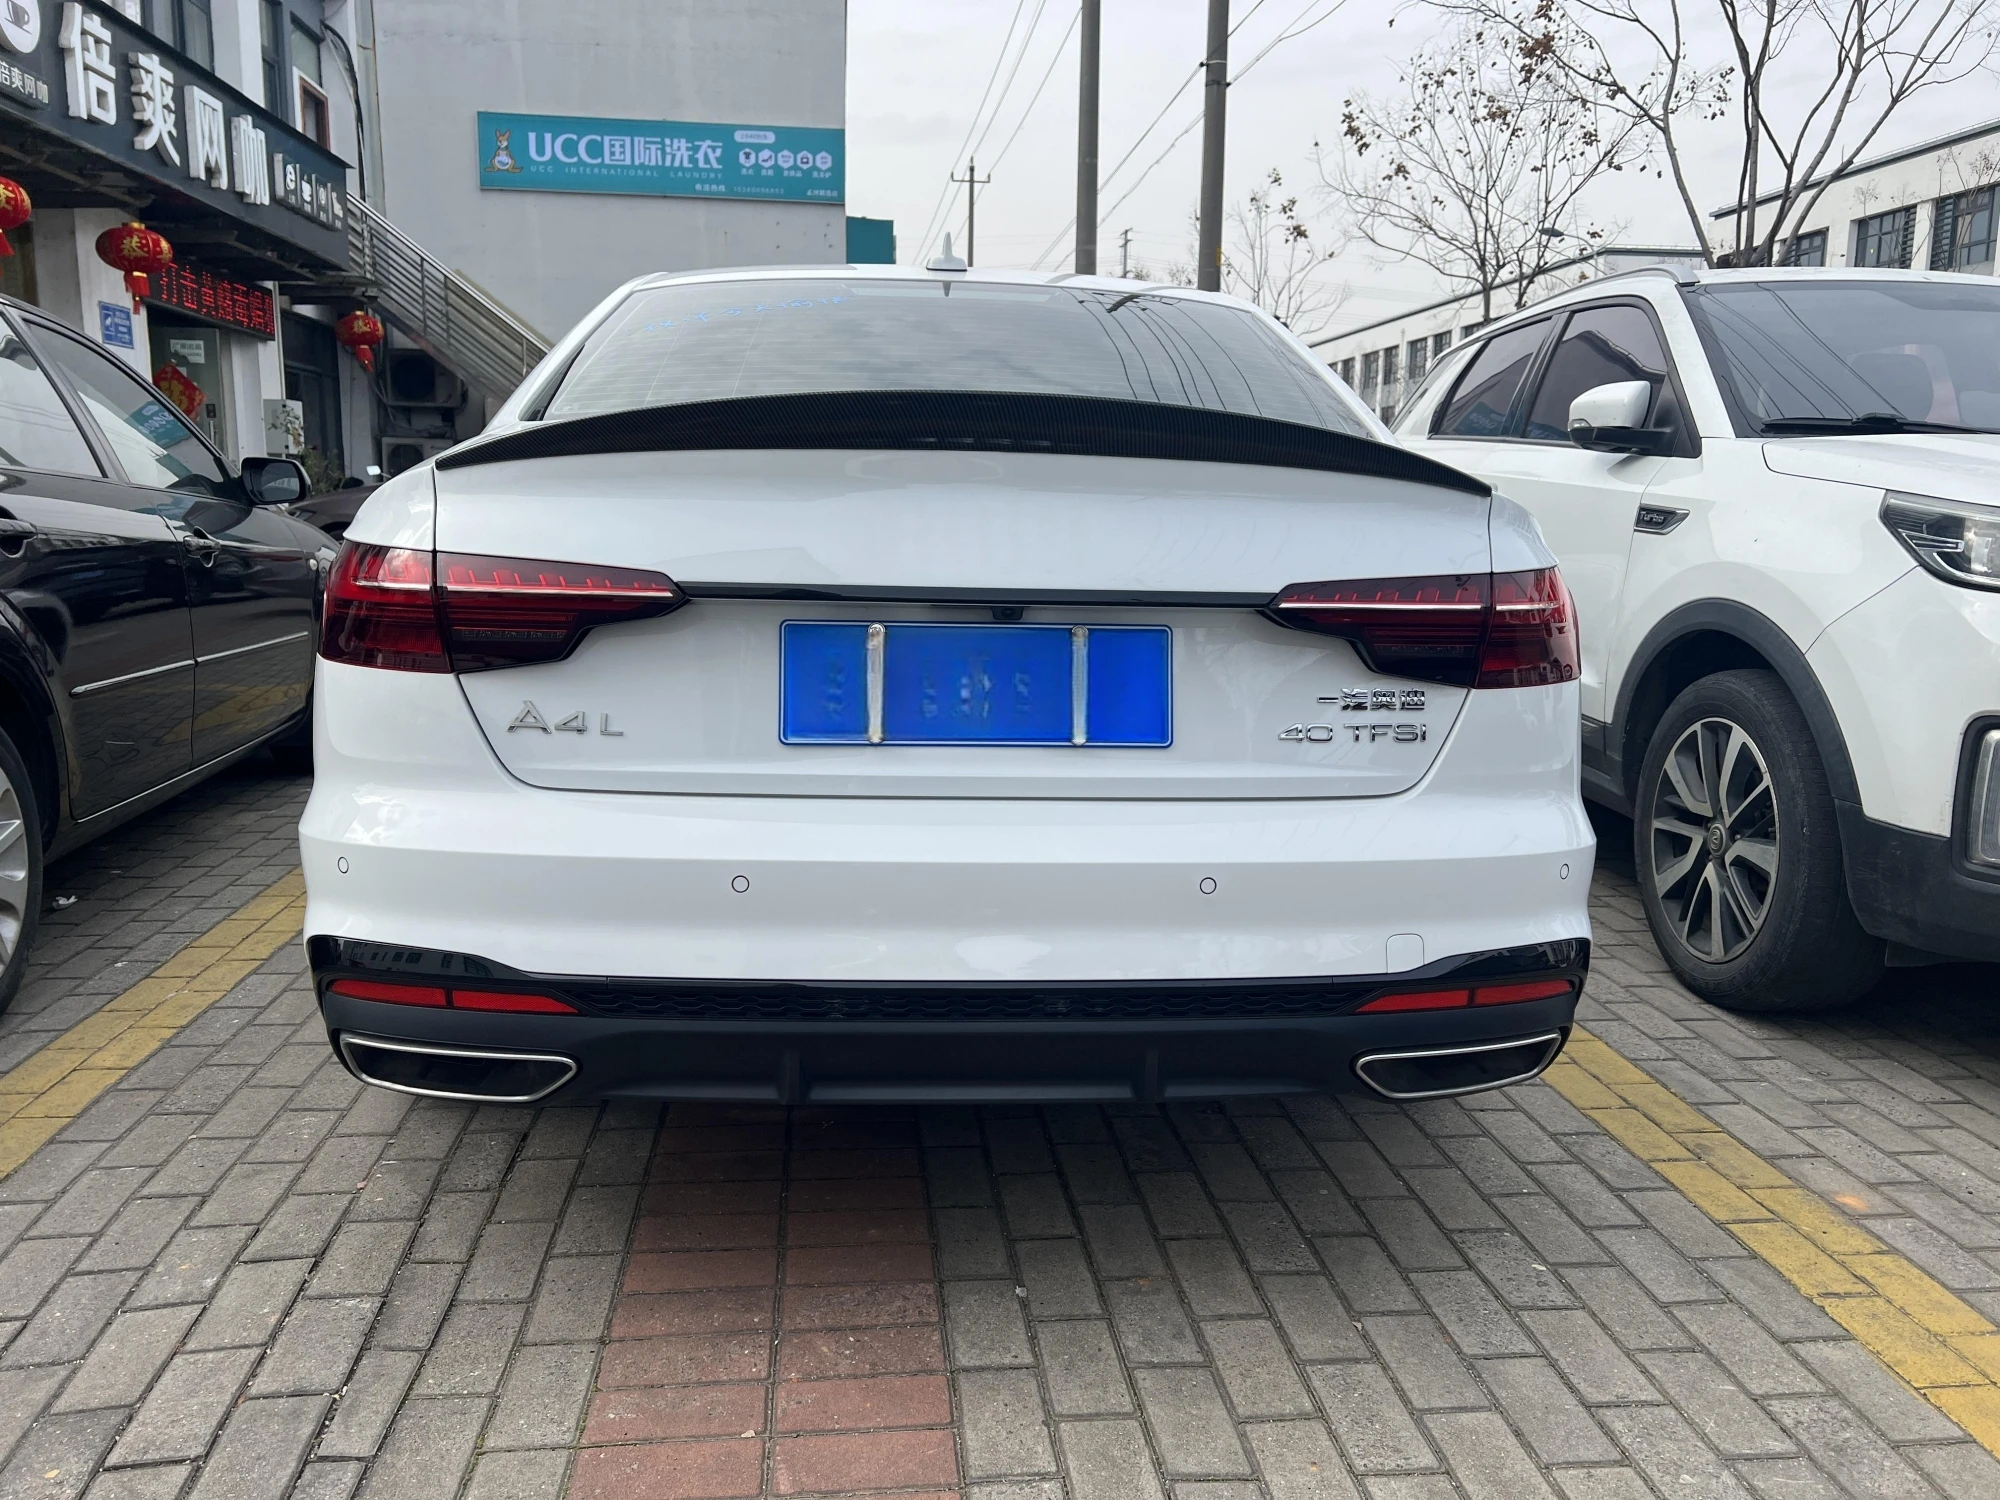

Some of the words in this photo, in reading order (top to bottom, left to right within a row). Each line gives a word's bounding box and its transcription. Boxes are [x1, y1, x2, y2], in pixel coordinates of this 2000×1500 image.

[58, 1, 270, 207] 倍爽网咖
[530, 165, 554, 173] UCC
[564, 166, 659, 178] INTERNATIONAL
[669, 171, 723, 180] LAUNDRY
[1317, 688, 1426, 711] 一汽奥迪
[1278, 723, 1334, 743] 40
